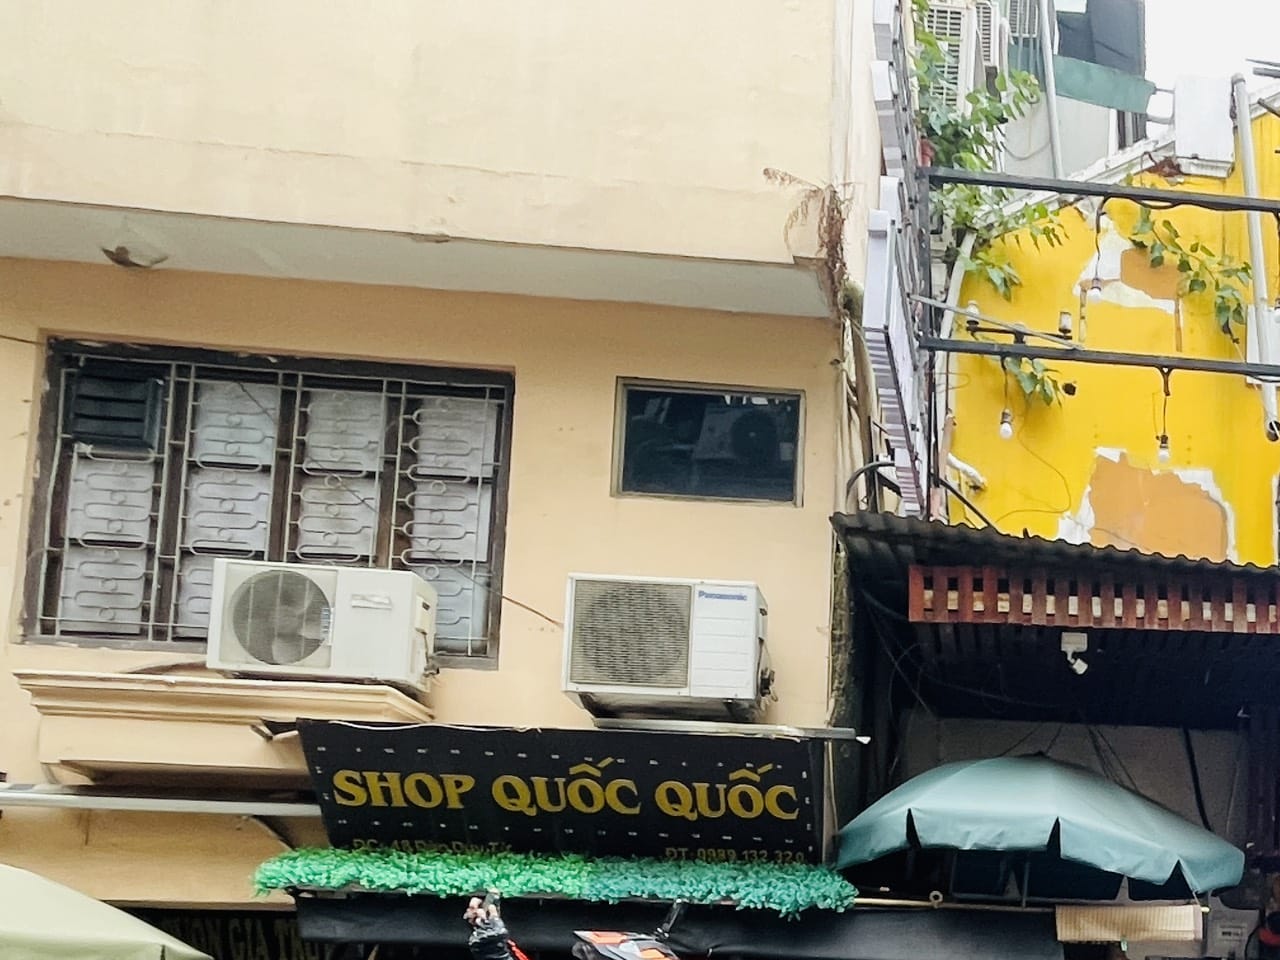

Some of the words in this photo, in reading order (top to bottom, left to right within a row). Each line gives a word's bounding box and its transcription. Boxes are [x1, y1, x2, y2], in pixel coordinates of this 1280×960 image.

[333, 769, 476, 808] SHOP
[491, 757, 642, 816] QUỐC
[654, 763, 800, 820] QUỐC
